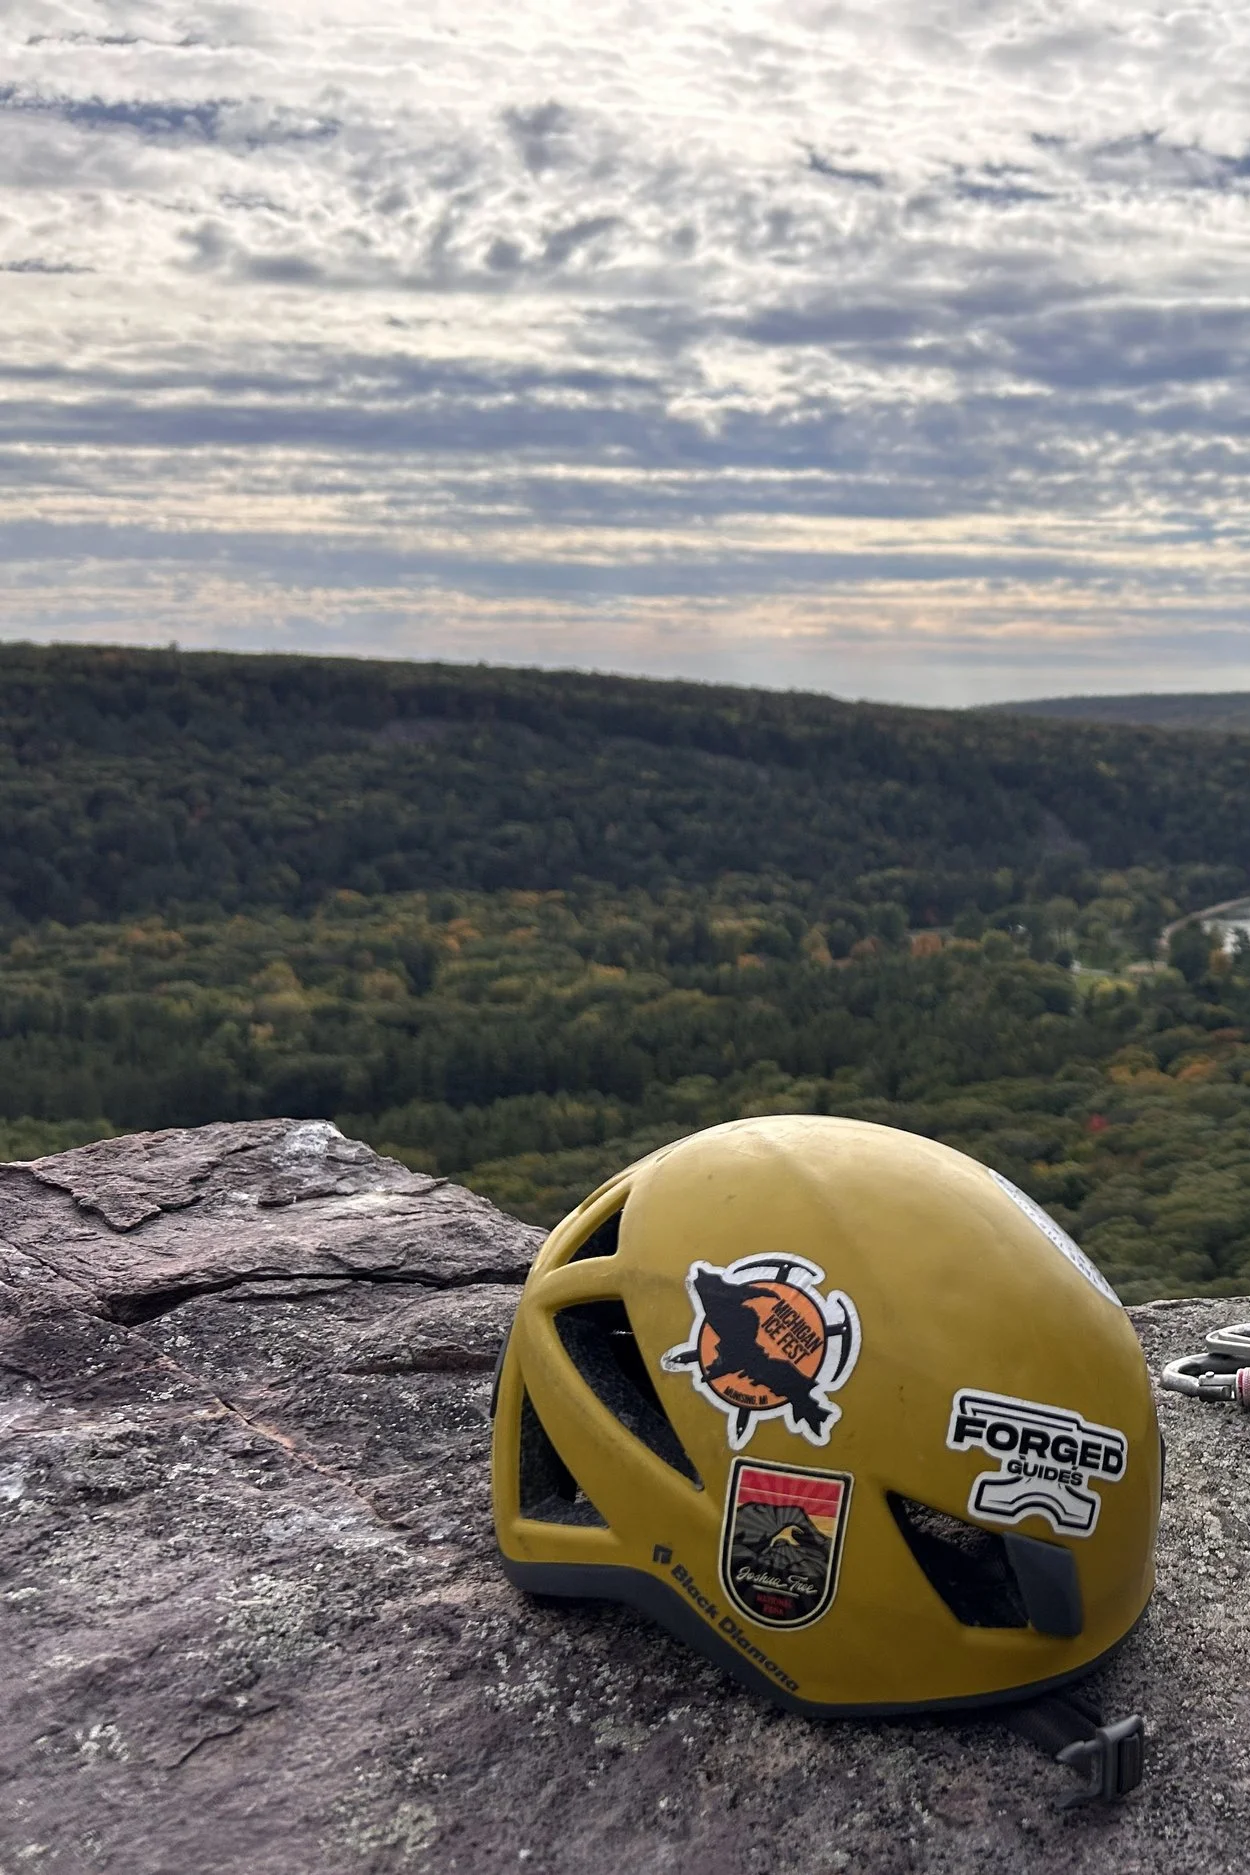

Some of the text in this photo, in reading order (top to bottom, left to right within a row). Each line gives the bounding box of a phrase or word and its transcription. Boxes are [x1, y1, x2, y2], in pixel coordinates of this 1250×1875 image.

[762, 1318, 811, 1363] ICE FEST
[772, 1299, 823, 1353] MICHIGAN
[759, 1394, 768, 1404] MI
[953, 1415, 1123, 1474] FORGED
[1007, 1459, 1083, 1486] GUIDES
[671, 1564, 719, 1619] Black
[736, 1566, 818, 1595] Joshua Tree
